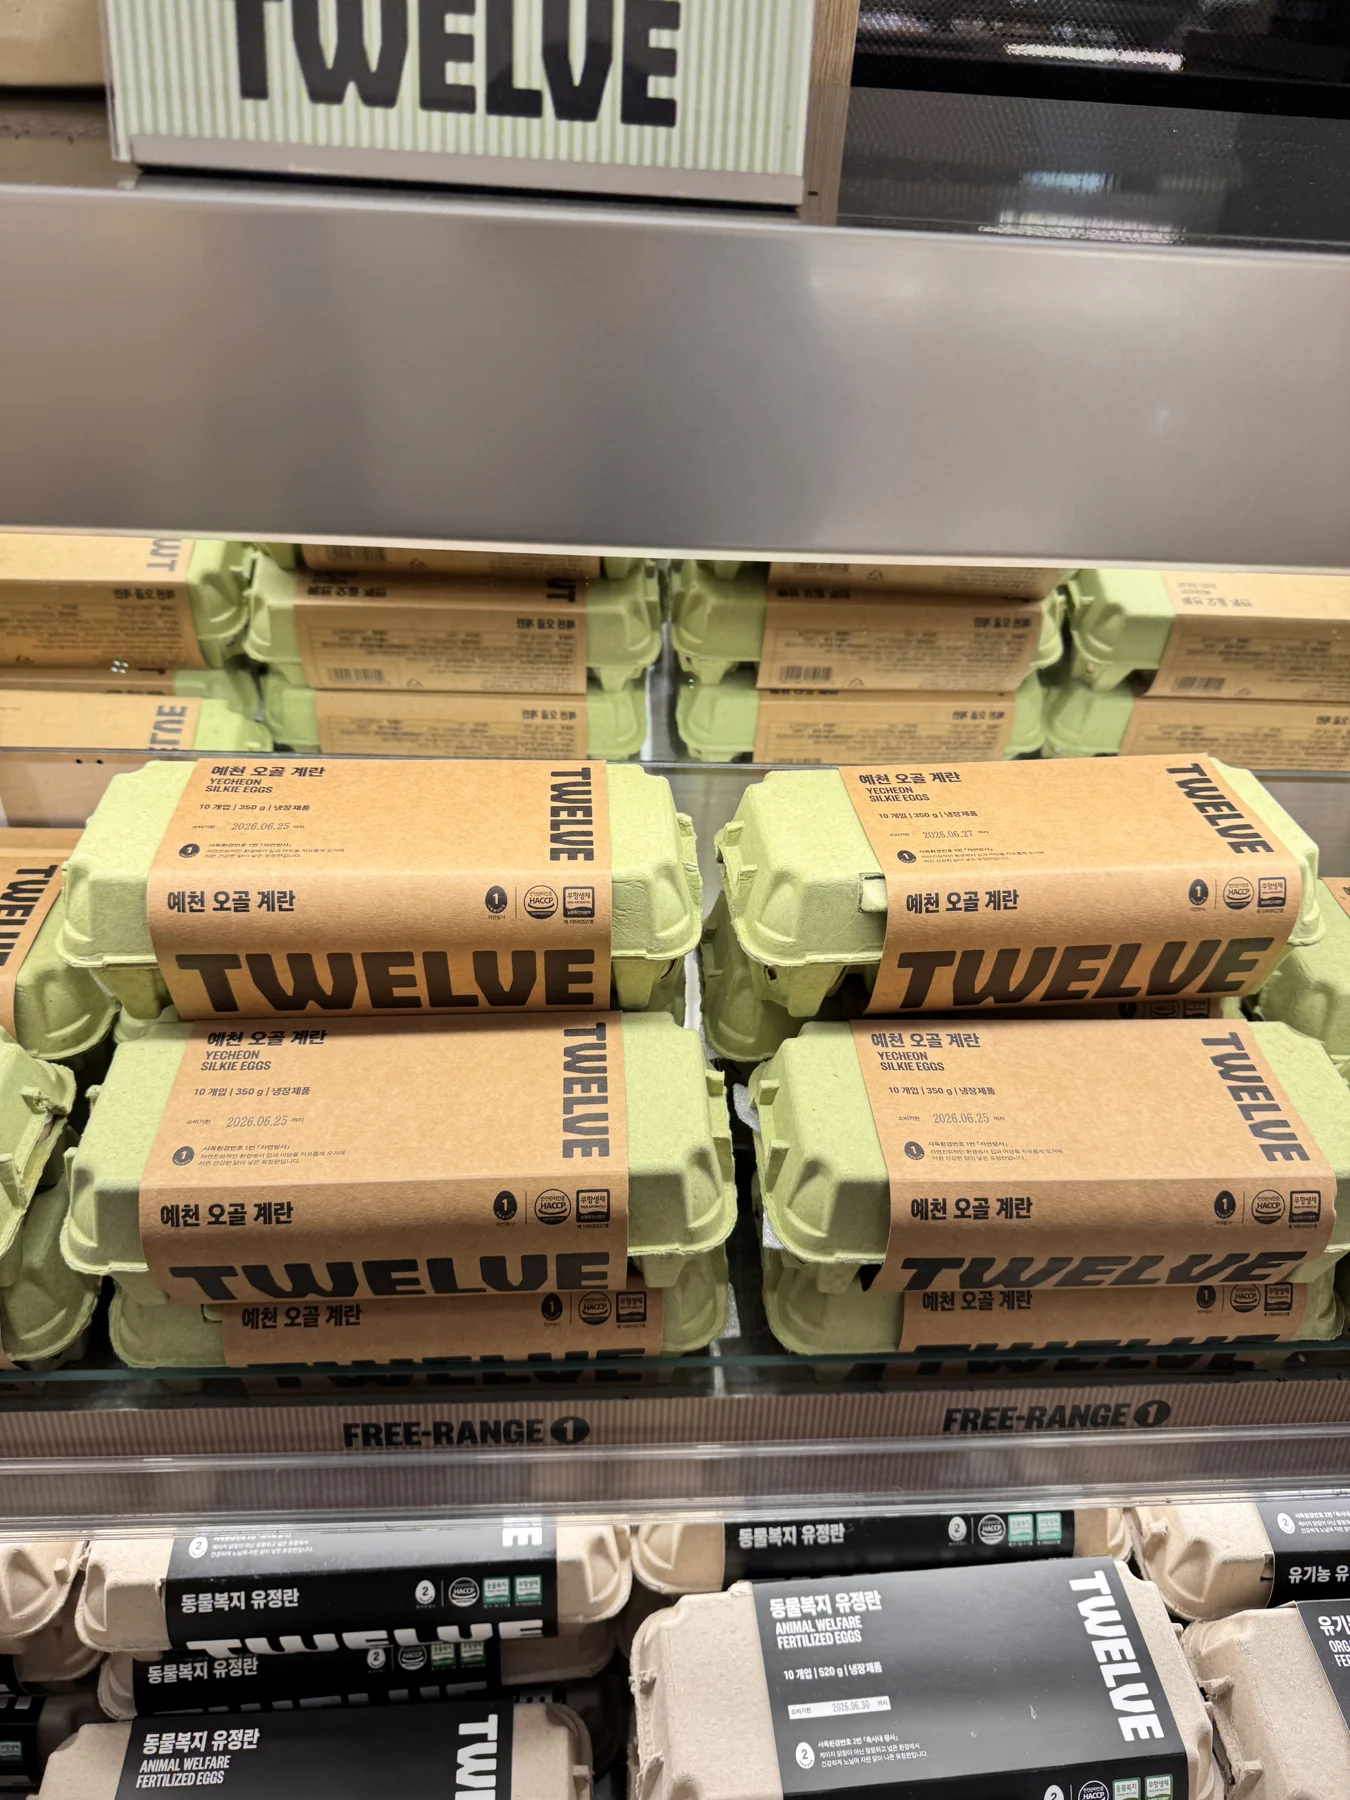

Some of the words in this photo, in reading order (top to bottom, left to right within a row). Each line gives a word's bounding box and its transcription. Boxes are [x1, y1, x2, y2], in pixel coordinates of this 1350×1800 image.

[234, 0, 681, 128] TWELVE
[211, 766, 247, 777] 예천
[250, 766, 285, 777] 오골
[290, 766, 326, 778] 계란
[858, 774, 891, 786] 예천
[895, 773, 927, 784] 오골
[931, 771, 962, 783] 계란
[209, 778, 262, 786] YECHEON
[243, 786, 273, 794] EGGS
[866, 786, 914, 795] YECHEON
[869, 794, 902, 803] SILKIE
[903, 793, 930, 802] EGGS
[550, 767, 594, 861] TWELVE
[1165, 763, 1275, 854] TWELVE
[230, 822, 290, 831] 2026.06.25
[922, 830, 973, 839] 2026.06.27
[492, 892, 499, 905] 1
[1195, 885, 1201, 897] 1
[167, 890, 206, 913] 예천
[212, 890, 251, 913] 오골
[257, 890, 296, 912] 계란
[905, 892, 940, 914] 예천
[945, 891, 980, 913] 오골
[985, 889, 1019, 912] 계란
[897, 936, 1274, 1009] TWELVE
[175, 949, 595, 1012] TWELVE
[207, 1032, 244, 1047] 예천
[248, 1031, 286, 1046] 오골
[290, 1029, 328, 1045] 계란
[871, 1033, 905, 1048] 예천
[910, 1033, 943, 1048] 오골
[948, 1033, 981, 1048] 계란
[205, 1050, 260, 1060] YECHEON
[877, 1051, 928, 1061] YECHEON
[200, 1061, 238, 1071] SILKIE
[239, 1060, 272, 1071] EGGS
[880, 1061, 915, 1071] SILKIE
[916, 1061, 945, 1071] EGGS
[194, 1088, 205, 1096] 10
[207, 1087, 228, 1096] 개입
[235, 1087, 255, 1096] 350
[562, 1022, 610, 1159] TWELVE
[888, 1086, 900, 1094] 10
[902, 1086, 919, 1095] 개입
[926, 1086, 944, 1095] 350
[1200, 1031, 1311, 1162] TWELVE
[226, 1115, 288, 1128] 2026.06.25
[932, 1112, 990, 1124] 2026.06.25
[501, 1198, 508, 1211] 1
[911, 1198, 948, 1221] 예천
[953, 1197, 991, 1220] 오골
[996, 1197, 1033, 1219] 계란
[1221, 1197, 1228, 1210] 1
[161, 1204, 200, 1228] 예천
[207, 1203, 247, 1226] 오골
[253, 1201, 294, 1226] 계란
[169, 1252, 610, 1300] TWELVE
[900, 1250, 1308, 1291] TWELVE
[549, 1301, 555, 1312] 1
[584, 1302, 607, 1310] HACCP
[922, 1290, 955, 1312] 예천
[960, 1289, 994, 1311] 오골
[999, 1289, 1033, 1310] 계란
[242, 1307, 278, 1330] 예천
[284, 1306, 320, 1328] 오골
[326, 1304, 362, 1326] 계란
[942, 1402, 1131, 1431] FREE-RANGE
[343, 1419, 544, 1447] FREE-RANGE
[954, 1523, 961, 1533] 2
[738, 1526, 797, 1549] 동물복지
[801, 1523, 846, 1546] 유정란
[1288, 1565, 1331, 1584] 유기농
[422, 1586, 429, 1596] 2
[181, 1590, 246, 1614] 동물복지
[251, 1588, 300, 1609] 유정란
[769, 1594, 833, 1619] 동물복지
[835, 1590, 883, 1613] 유정란
[775, 1619, 816, 1636] ANIMAL
[815, 1615, 863, 1632] WELFARE
[777, 1632, 834, 1650] FERTILIZED
[836, 1629, 863, 1644] EGGS
[373, 1651, 380, 1661] 2
[1069, 1570, 1165, 1742] TWELVE
[147, 1660, 208, 1684] 동물복지
[213, 1657, 259, 1678] 유정란
[783, 1670, 794, 1680] 10
[796, 1668, 813, 1680] 개입
[819, 1665, 836, 1678] 520
[836, 1667, 844, 1677] g
[832, 1699, 870, 1713] 2026.06.30
[142, 1731, 208, 1755] 동물복지
[211, 1728, 261, 1751] 유정란
[802, 1748, 809, 1760] 2
[139, 1757, 181, 1773] ANIMAL
[183, 1755, 231, 1771] WELFARE
[135, 1772, 195, 1789] FERTILIZED
[196, 1771, 225, 1786] EGGS
[1083, 1792, 1106, 1800] HACCP
